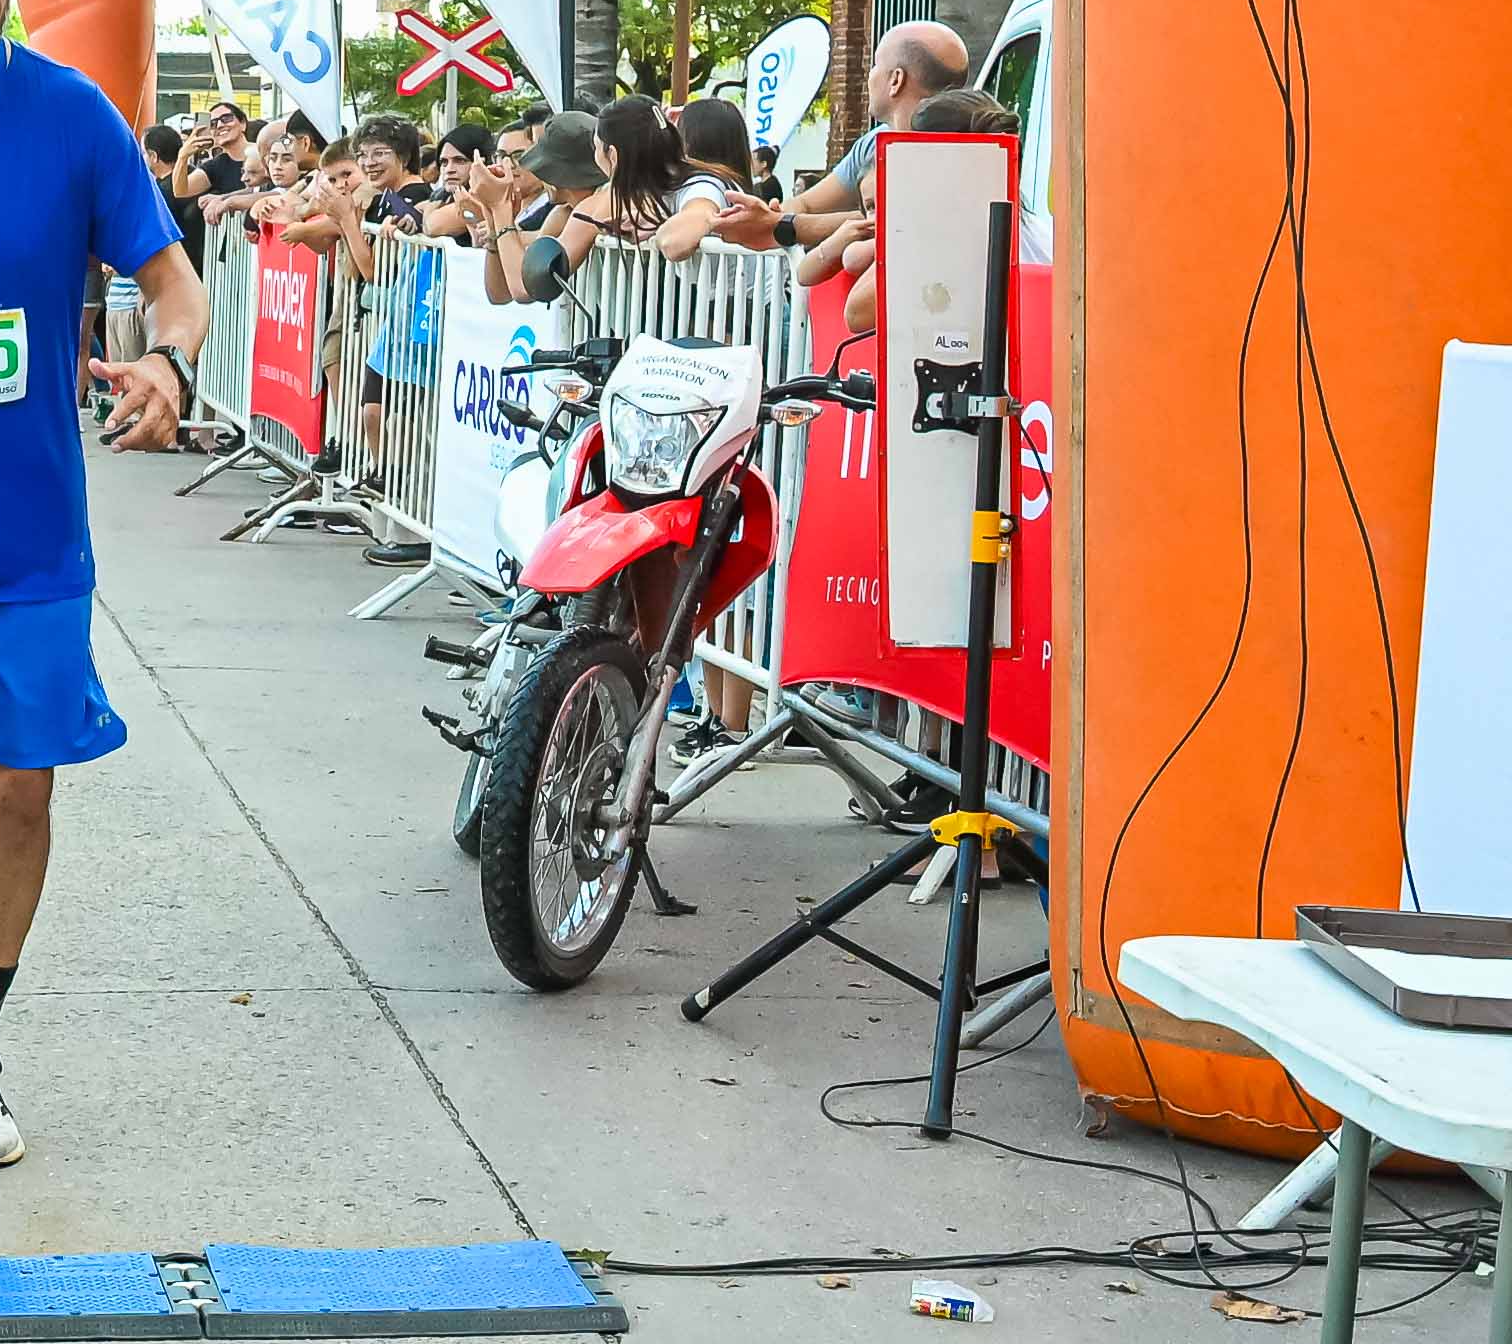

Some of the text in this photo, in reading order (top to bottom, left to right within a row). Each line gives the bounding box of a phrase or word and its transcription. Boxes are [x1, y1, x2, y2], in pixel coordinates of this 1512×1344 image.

[262, 249, 307, 343] moplex
[453, 360, 530, 444] CARUSO
[642, 367, 706, 386] MARATON
[826, 575, 880, 607] TECNO
